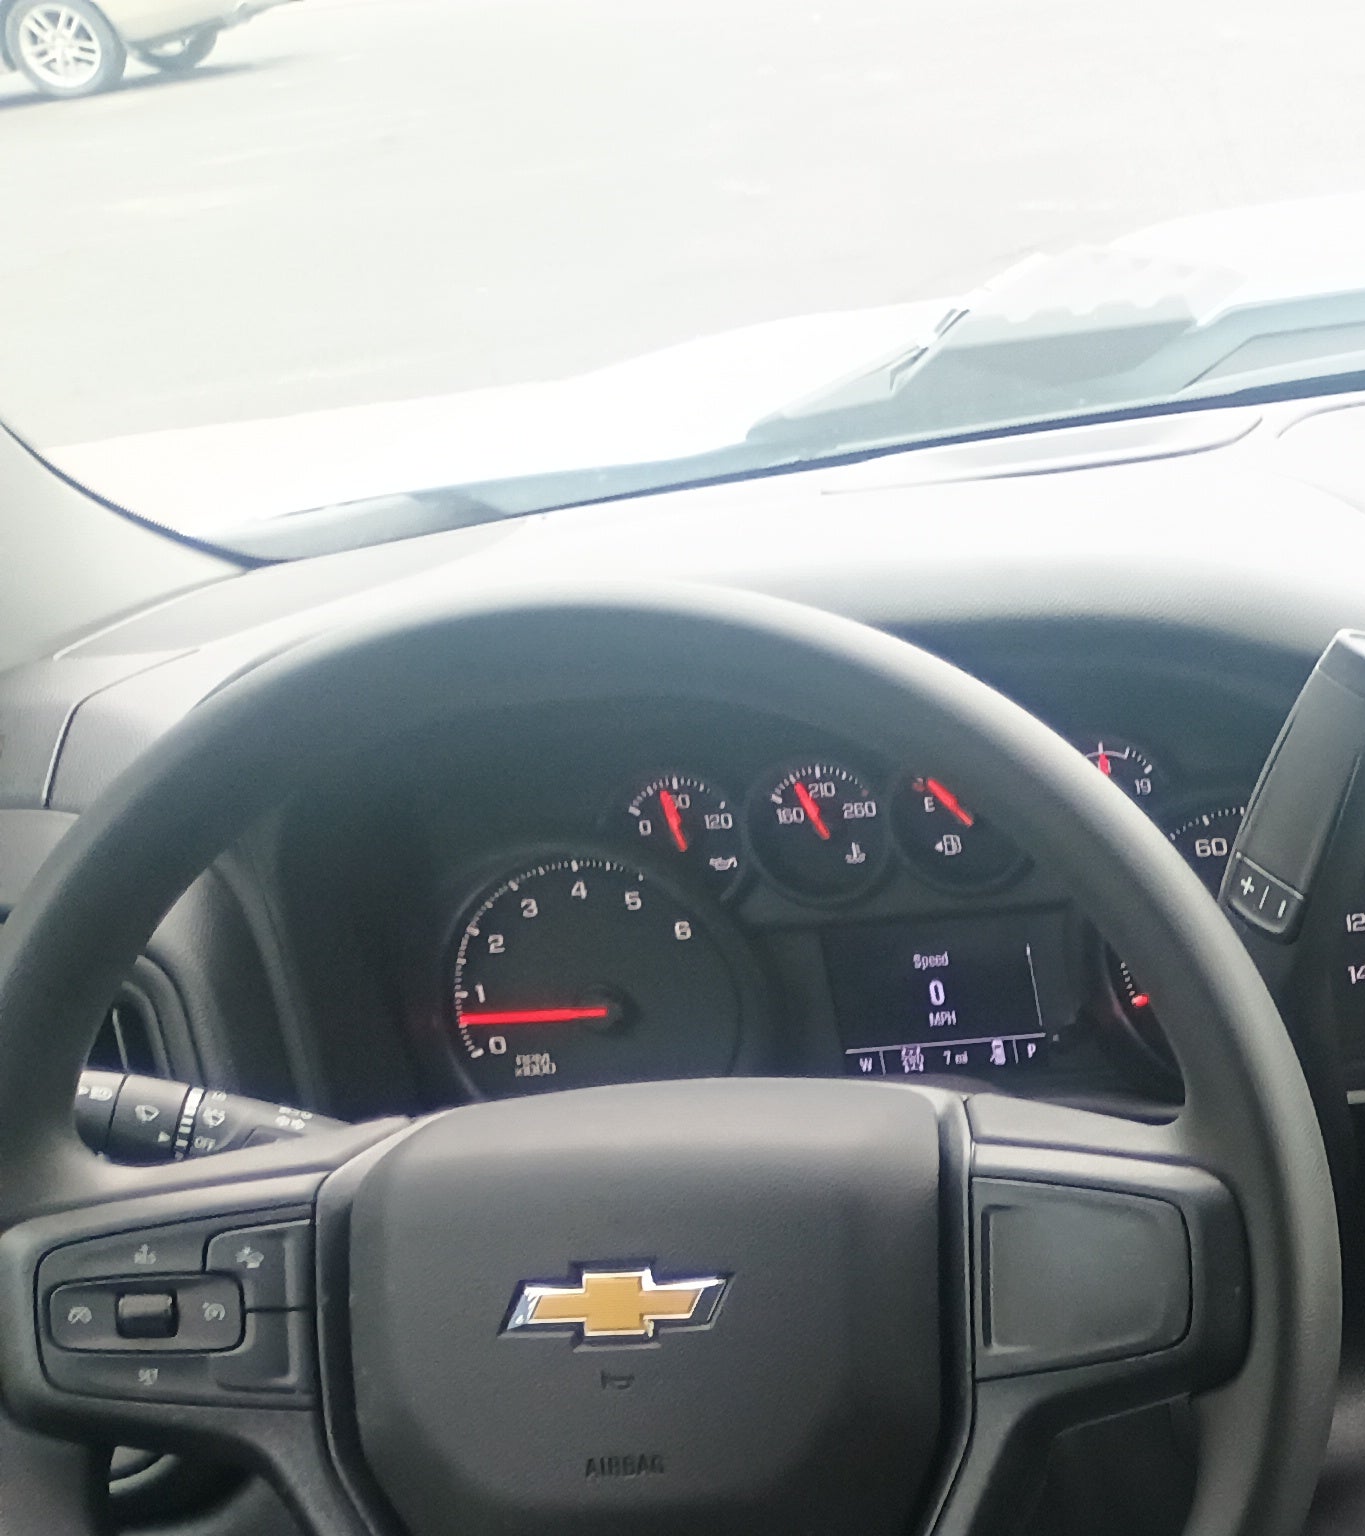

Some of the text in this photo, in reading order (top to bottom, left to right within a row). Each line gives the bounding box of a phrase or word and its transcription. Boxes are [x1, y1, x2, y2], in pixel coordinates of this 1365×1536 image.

[639, 819, 652, 836] 0
[704, 812, 733, 830] 120
[1195, 837, 1228, 858] 60
[570, 880, 588, 900] 4
[520, 898, 539, 918] 3
[624, 890, 642, 911] 5
[487, 934, 506, 954] 2
[912, 951, 949, 970] Speed
[475, 983, 486, 1004] 1
[928, 978, 946, 1006] 0
[488, 1035, 507, 1055] 0
